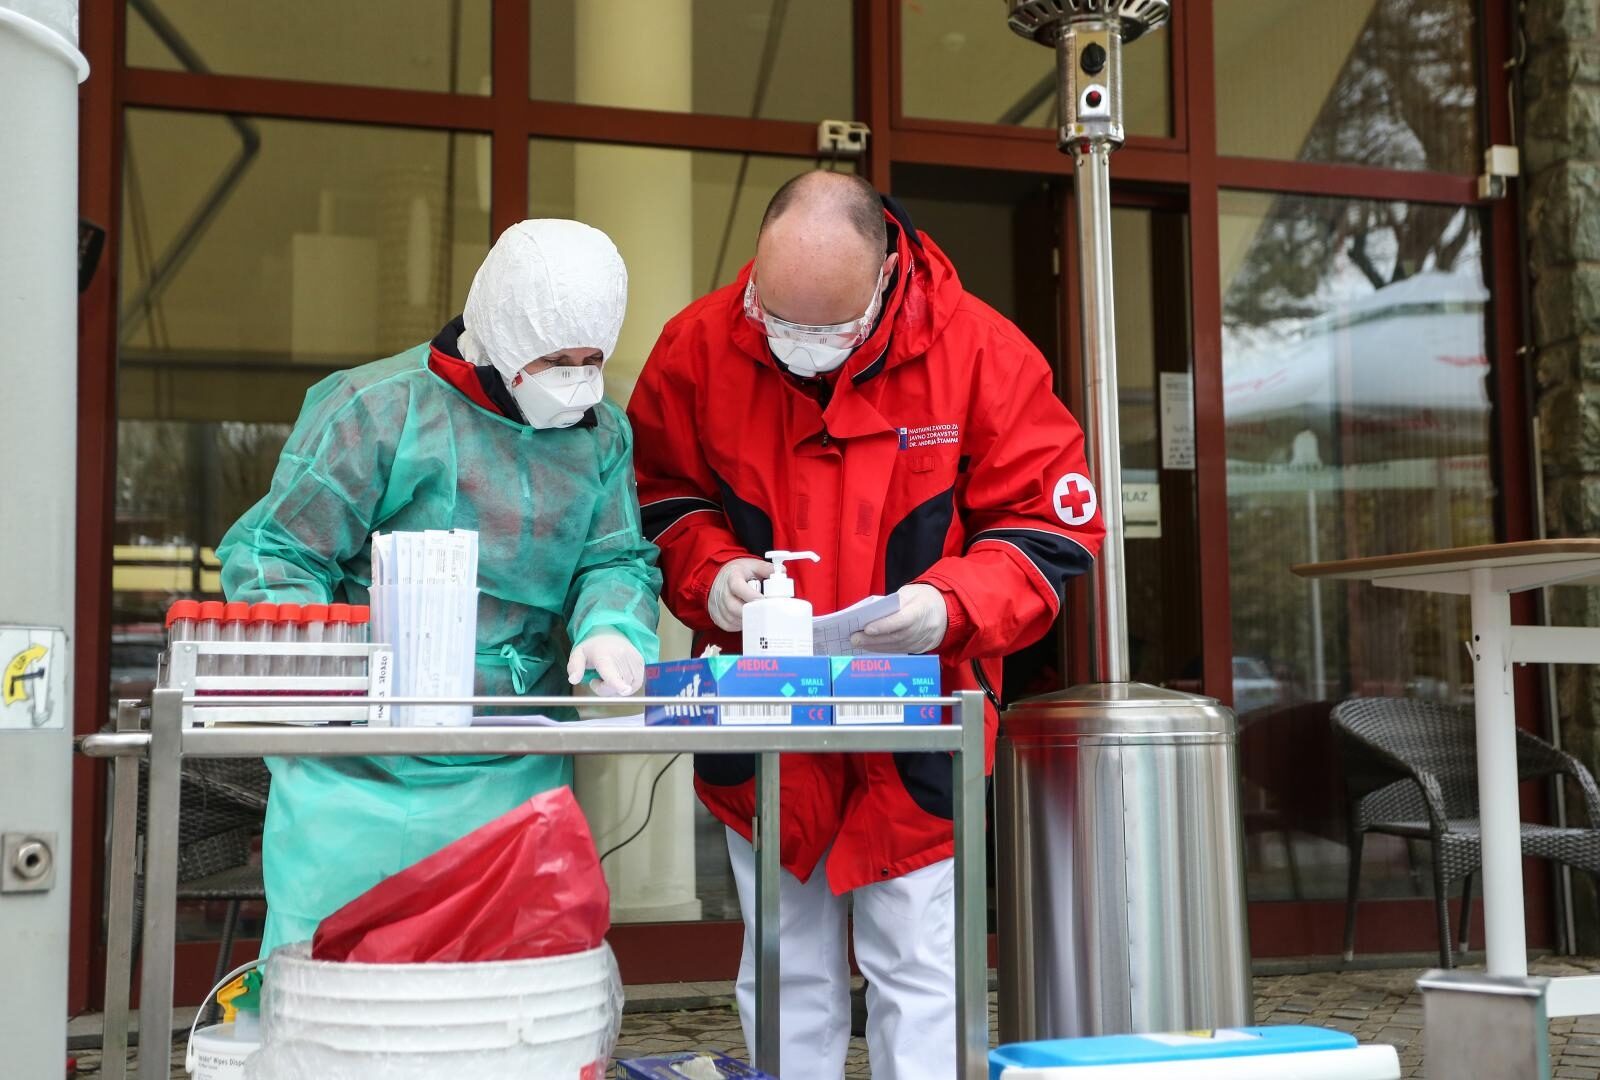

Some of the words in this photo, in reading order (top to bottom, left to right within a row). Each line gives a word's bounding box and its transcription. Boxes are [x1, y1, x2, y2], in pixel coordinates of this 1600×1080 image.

[737, 659, 779, 671] MEDICA
[851, 660, 891, 671] MEDICA
[801, 678, 824, 686] SMALL
[912, 678, 935, 686] SMALL
